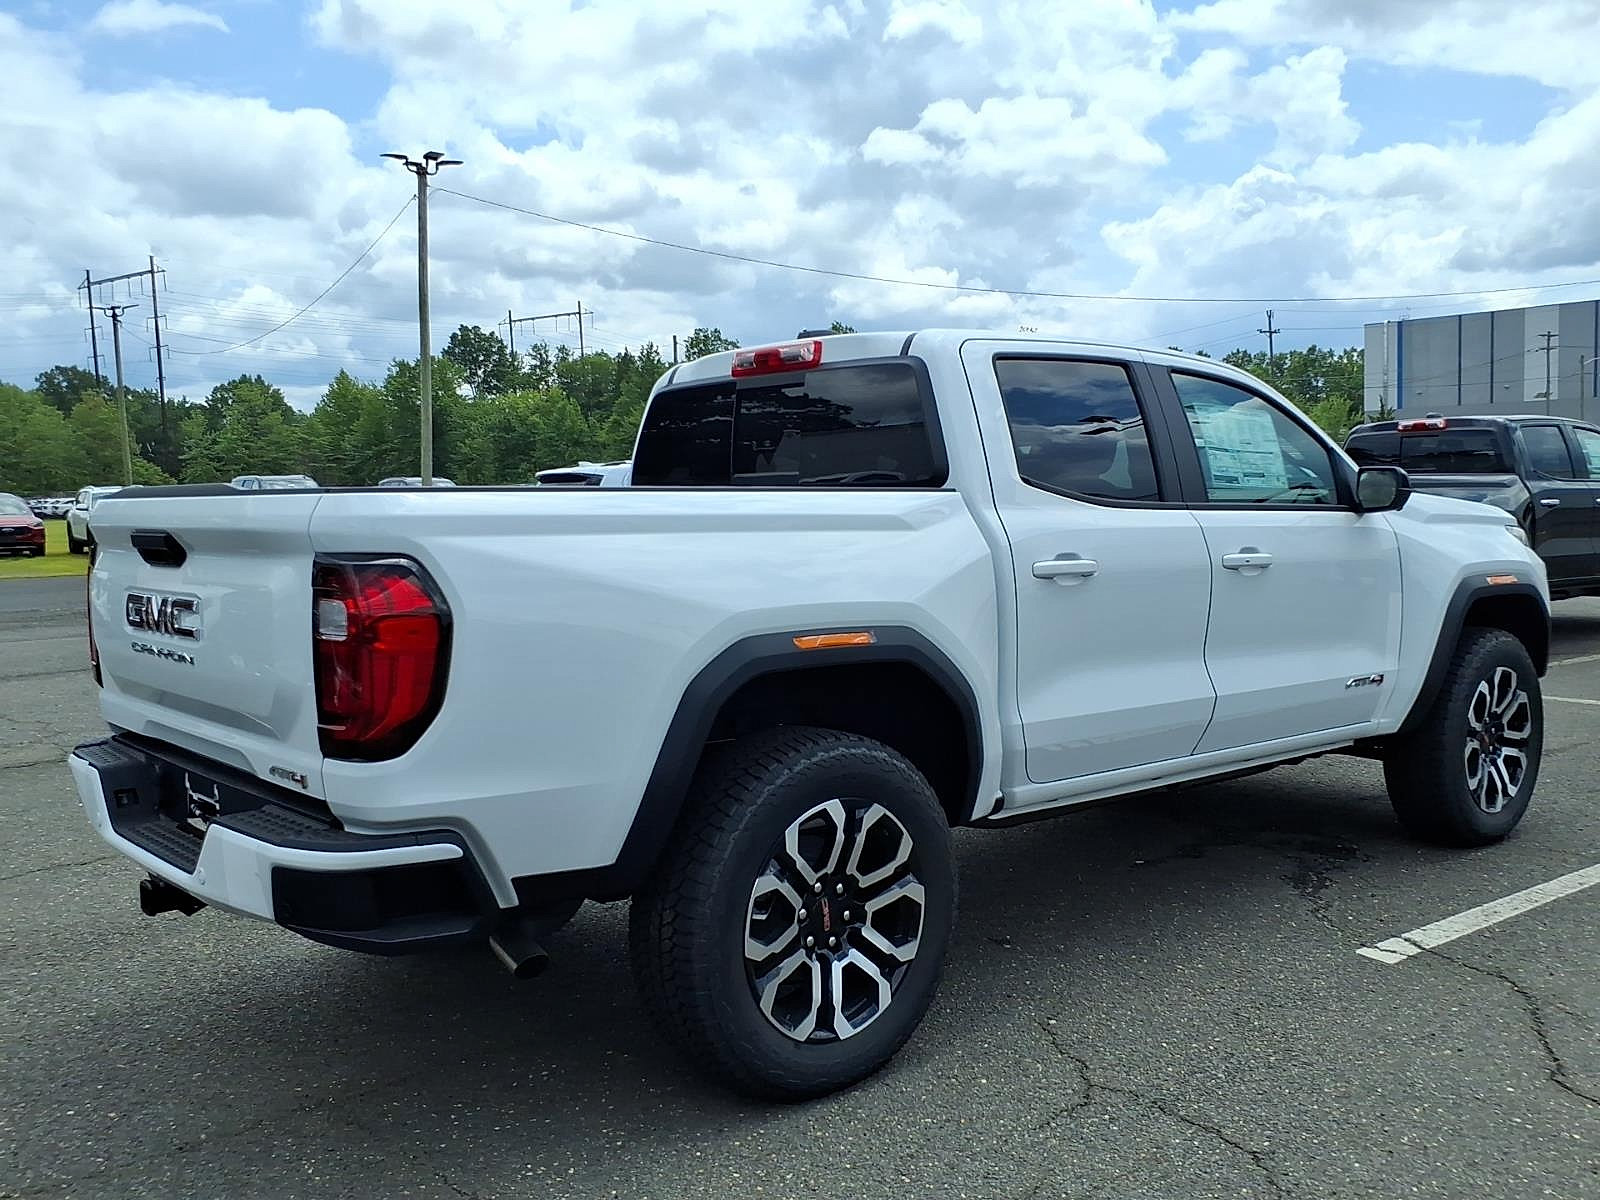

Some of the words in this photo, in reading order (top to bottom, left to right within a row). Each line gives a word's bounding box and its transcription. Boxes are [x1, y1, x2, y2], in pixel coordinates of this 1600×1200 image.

[126, 592, 201, 642] GMC
[131, 641, 195, 665] CANYON
[1345, 674, 1384, 690] AT4
[269, 766, 309, 790] AT4
